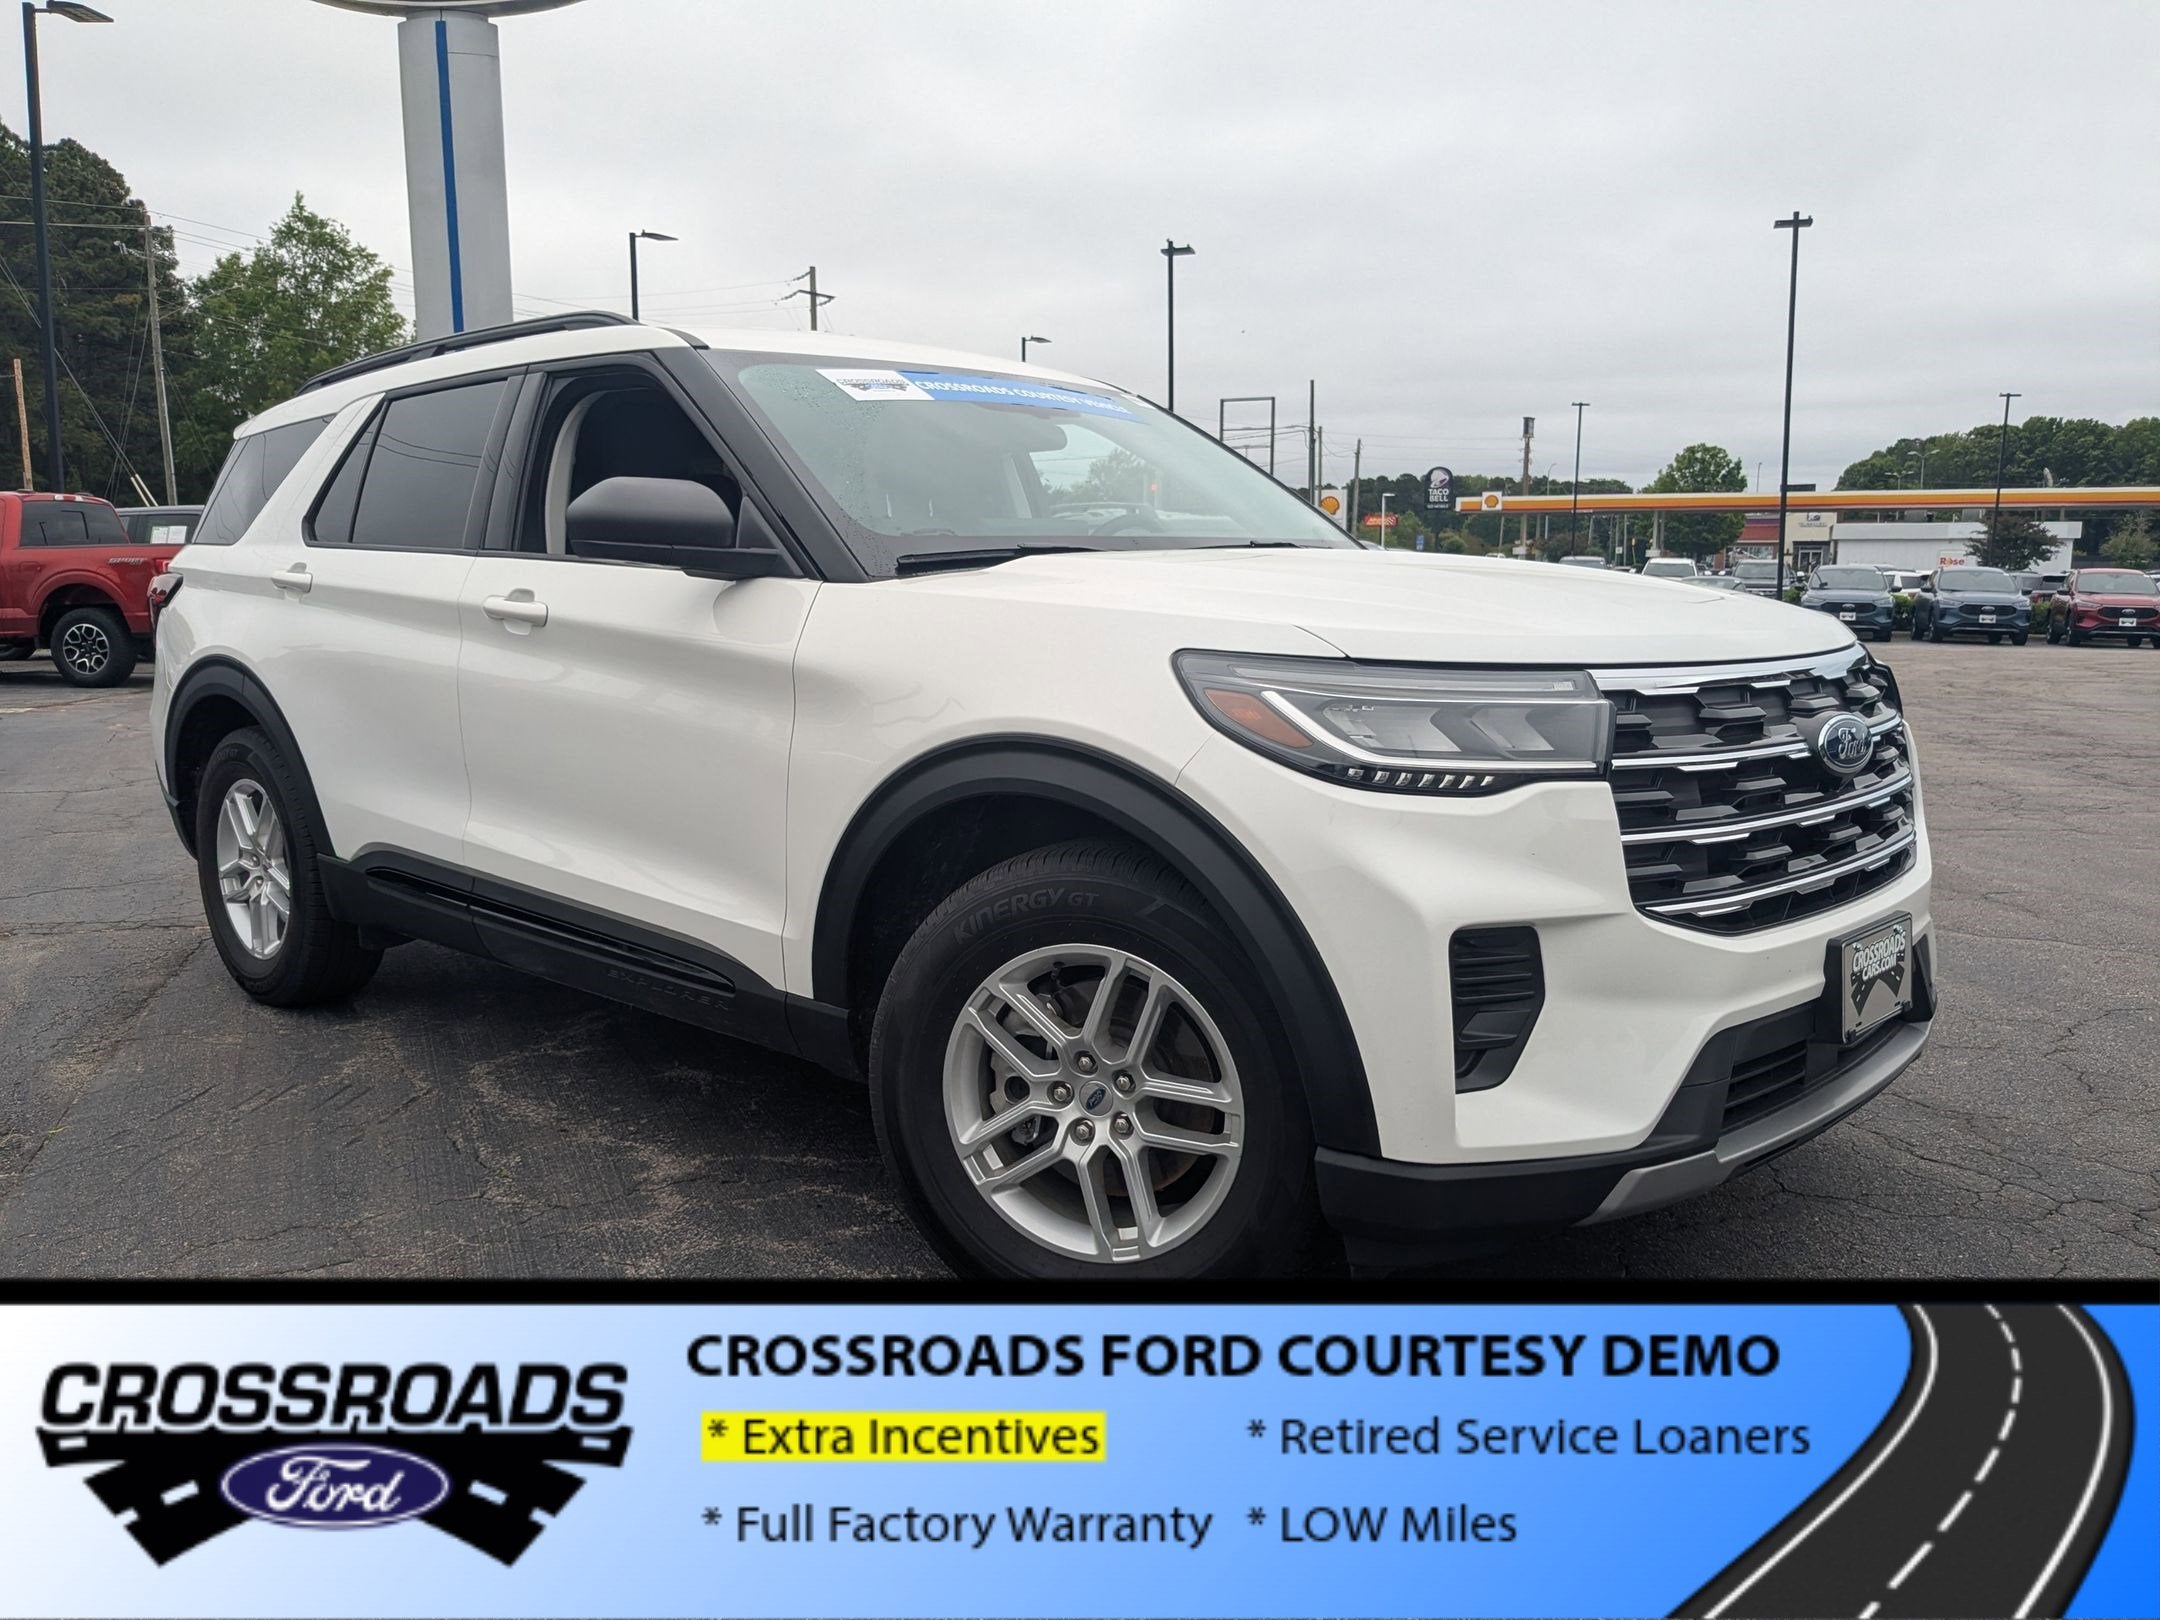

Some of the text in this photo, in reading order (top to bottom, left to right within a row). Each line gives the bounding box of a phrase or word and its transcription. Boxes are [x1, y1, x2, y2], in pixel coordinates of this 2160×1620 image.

[914, 381, 1014, 396] CROSSROADS
[954, 887, 1100, 944] KINERGY GT
[1852, 931, 1906, 972] CROSSROADS
[1862, 954, 1897, 981] CARS.COM
